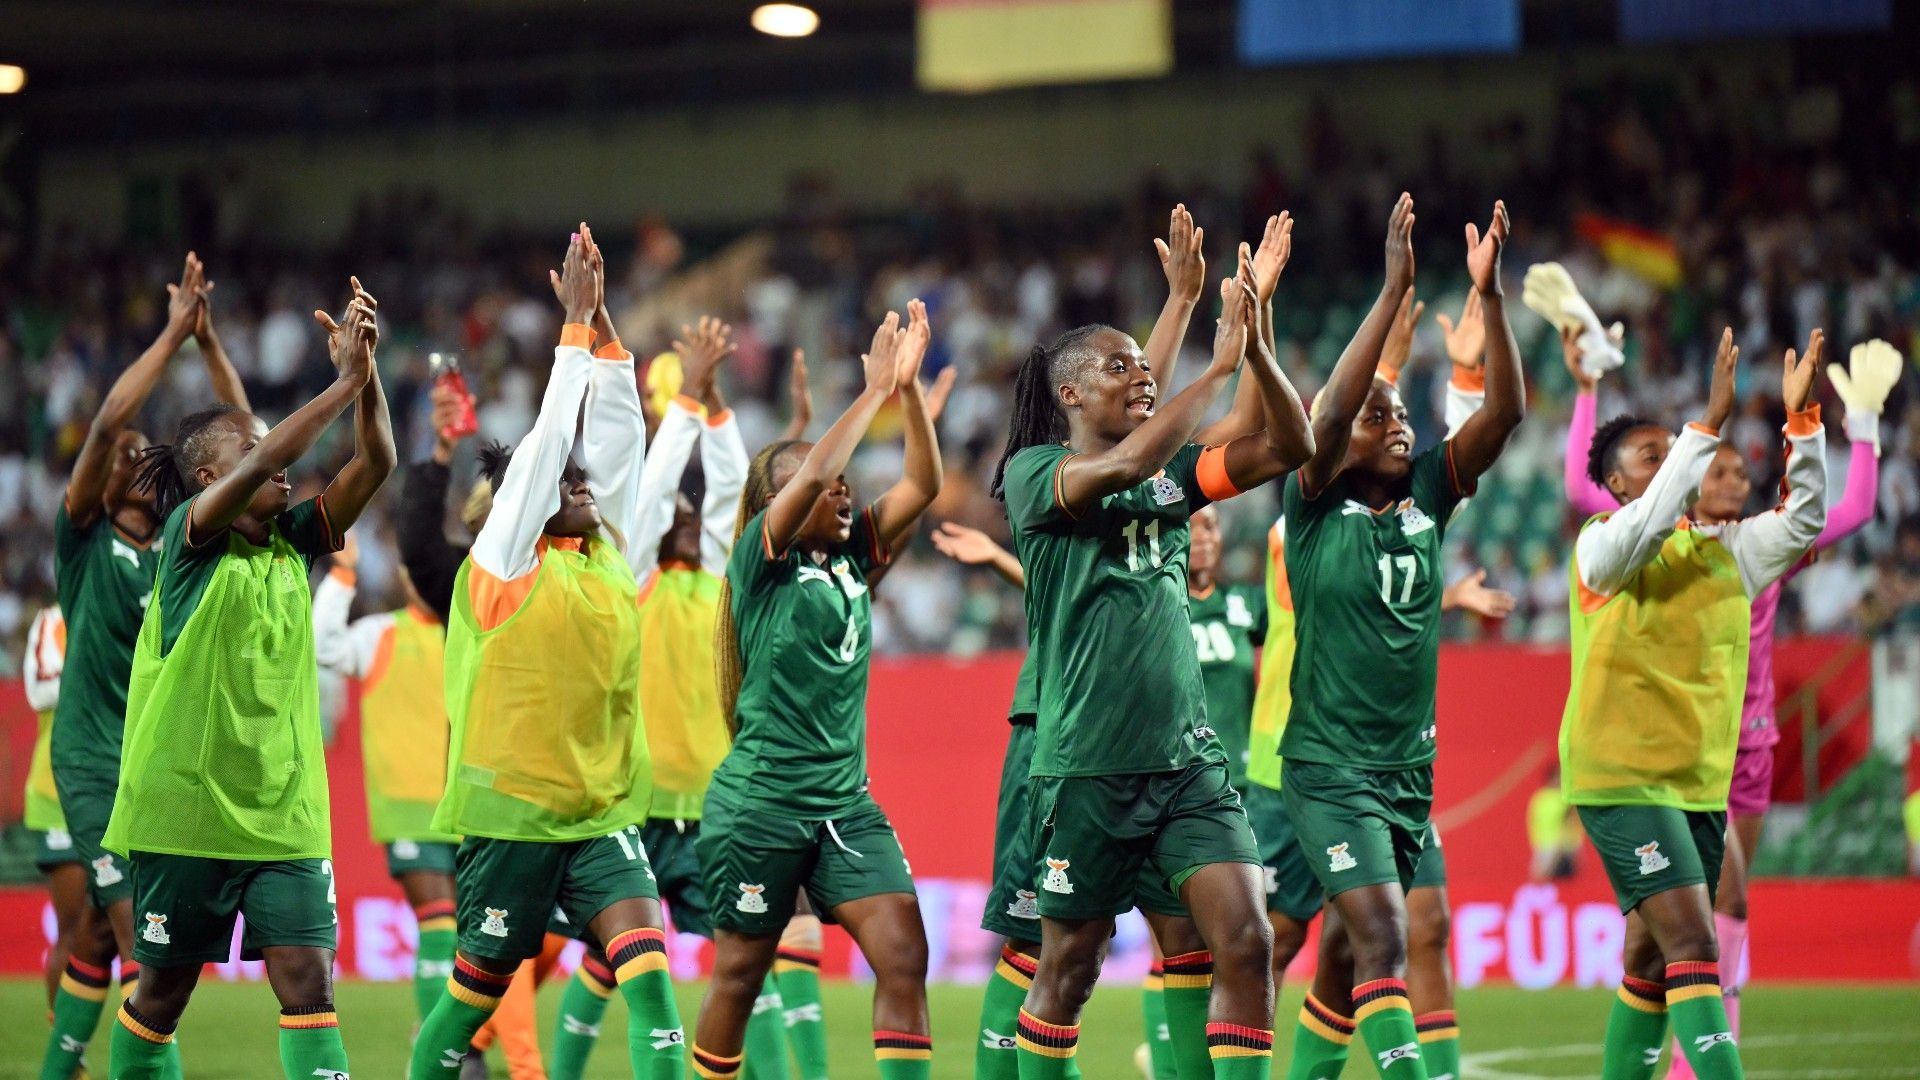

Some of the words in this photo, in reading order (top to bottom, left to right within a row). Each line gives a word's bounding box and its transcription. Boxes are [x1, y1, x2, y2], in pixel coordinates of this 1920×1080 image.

[1122, 519, 1164, 572] 11
[1378, 553, 1416, 604] 17
[840, 615, 859, 663] 6
[1191, 621, 1236, 662] 20
[1454, 884, 1626, 989] FÜR
